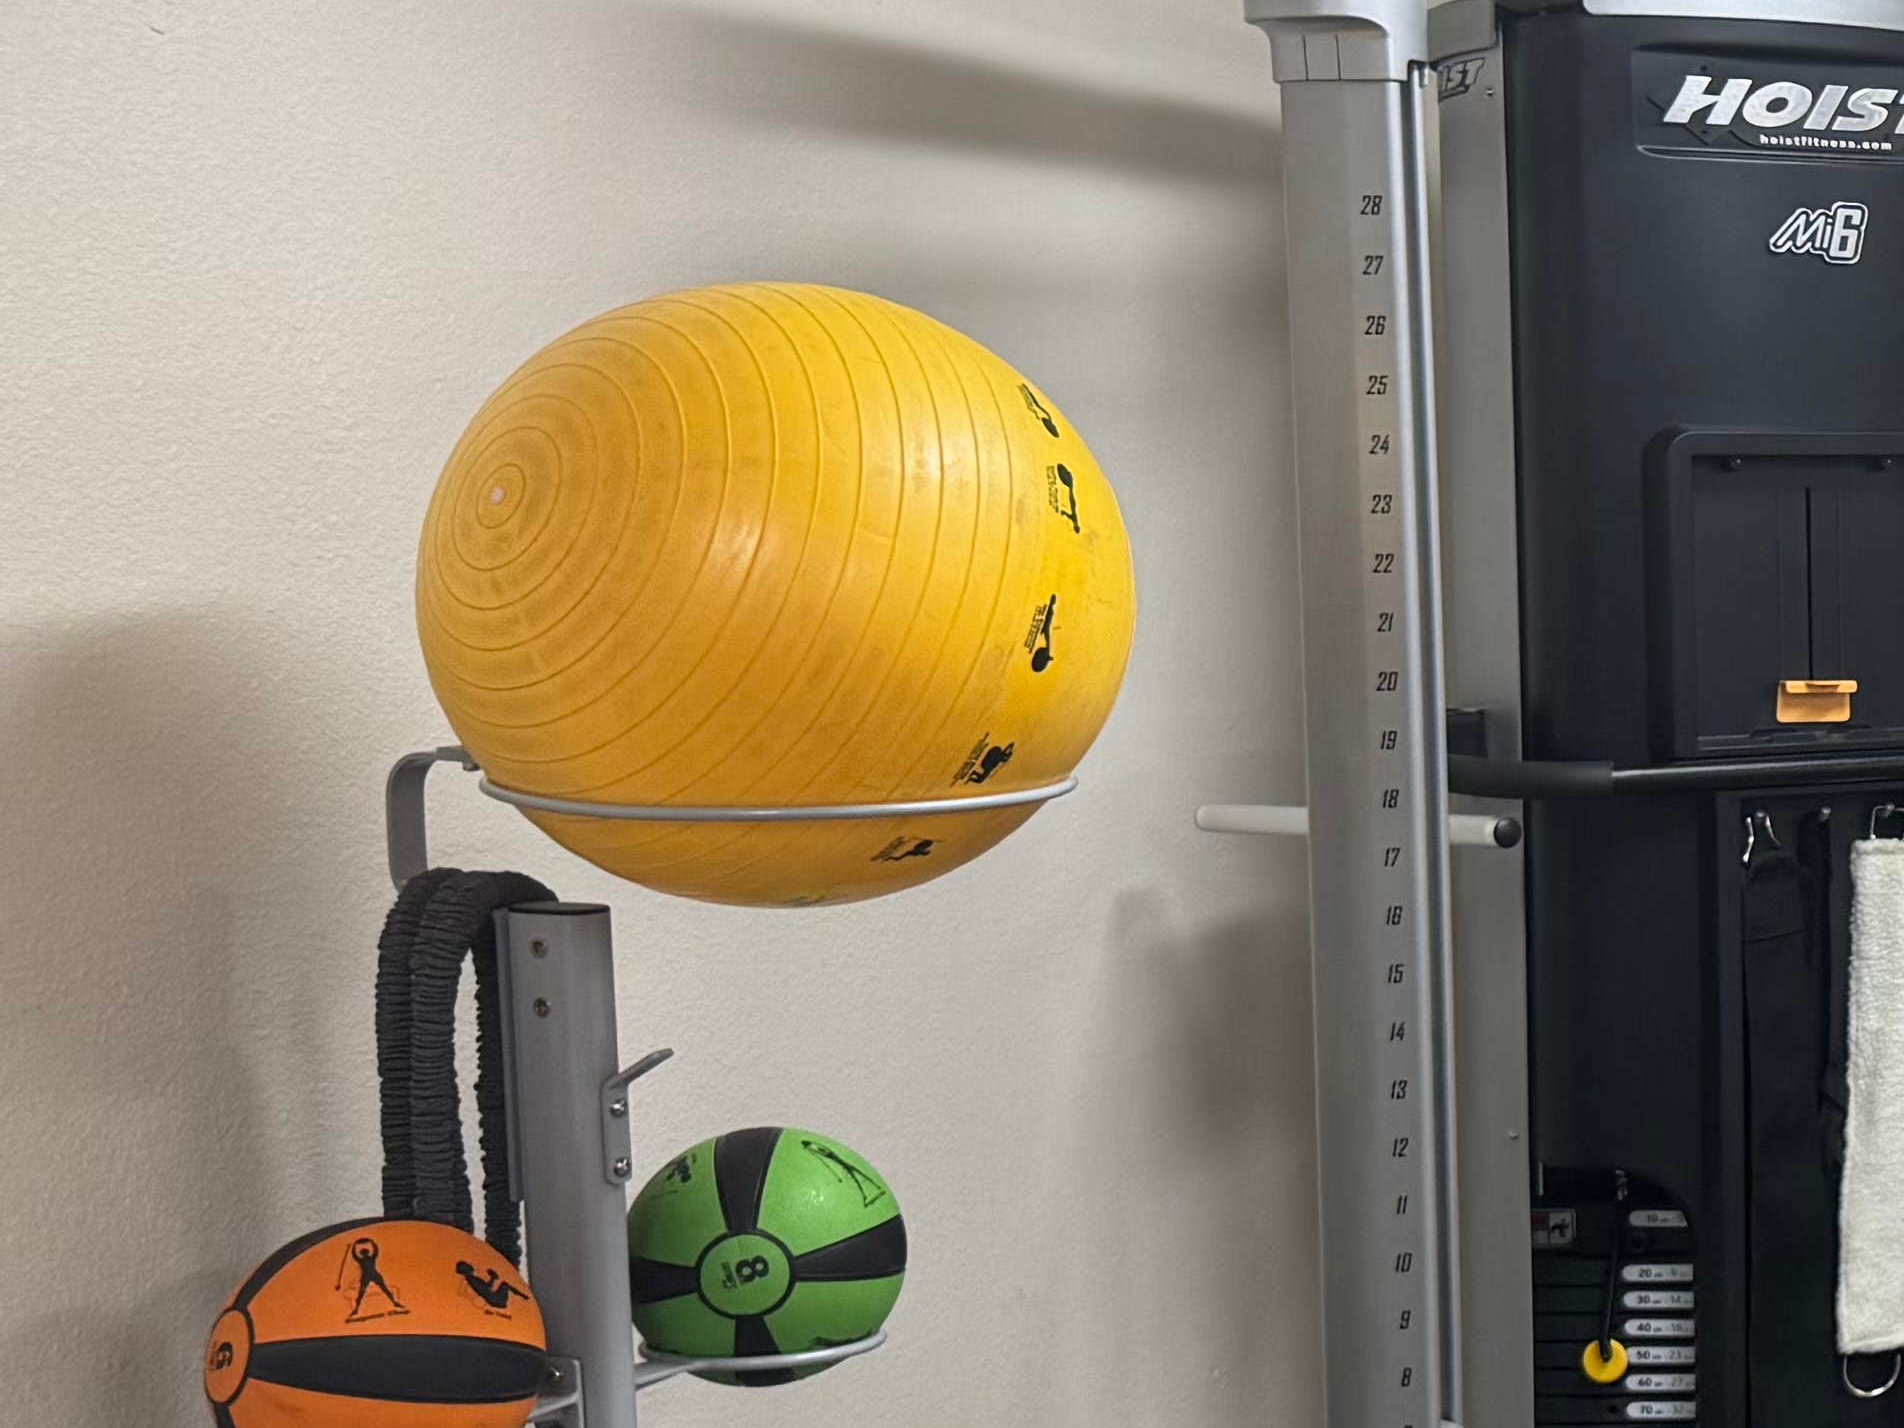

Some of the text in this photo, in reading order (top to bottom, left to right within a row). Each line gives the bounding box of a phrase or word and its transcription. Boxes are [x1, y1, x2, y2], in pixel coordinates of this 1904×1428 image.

[1360, 195, 1382, 215] 28
[1362, 255, 1384, 275] 27
[1364, 316, 1386, 335] 26
[1366, 375, 1388, 395] 25
[1369, 435, 1389, 454] 24
[1370, 494, 1392, 514] 23
[1373, 553, 1394, 573] 22
[1377, 612, 1393, 632] 21
[1376, 671, 1398, 691] 20
[1381, 731, 1397, 750] 19
[1383, 789, 1399, 808] 18
[1384, 848, 1400, 867] 17
[1390, 1022, 1404, 1041] 14
[1391, 1080, 1408, 1100] 13
[1392, 1138, 1409, 1157] 12
[1397, 1195, 1408, 1214] 11
[735, 1256, 769, 1283] 8
[1395, 1253, 1412, 1272] 10
[1401, 1368, 1412, 1387] 8
